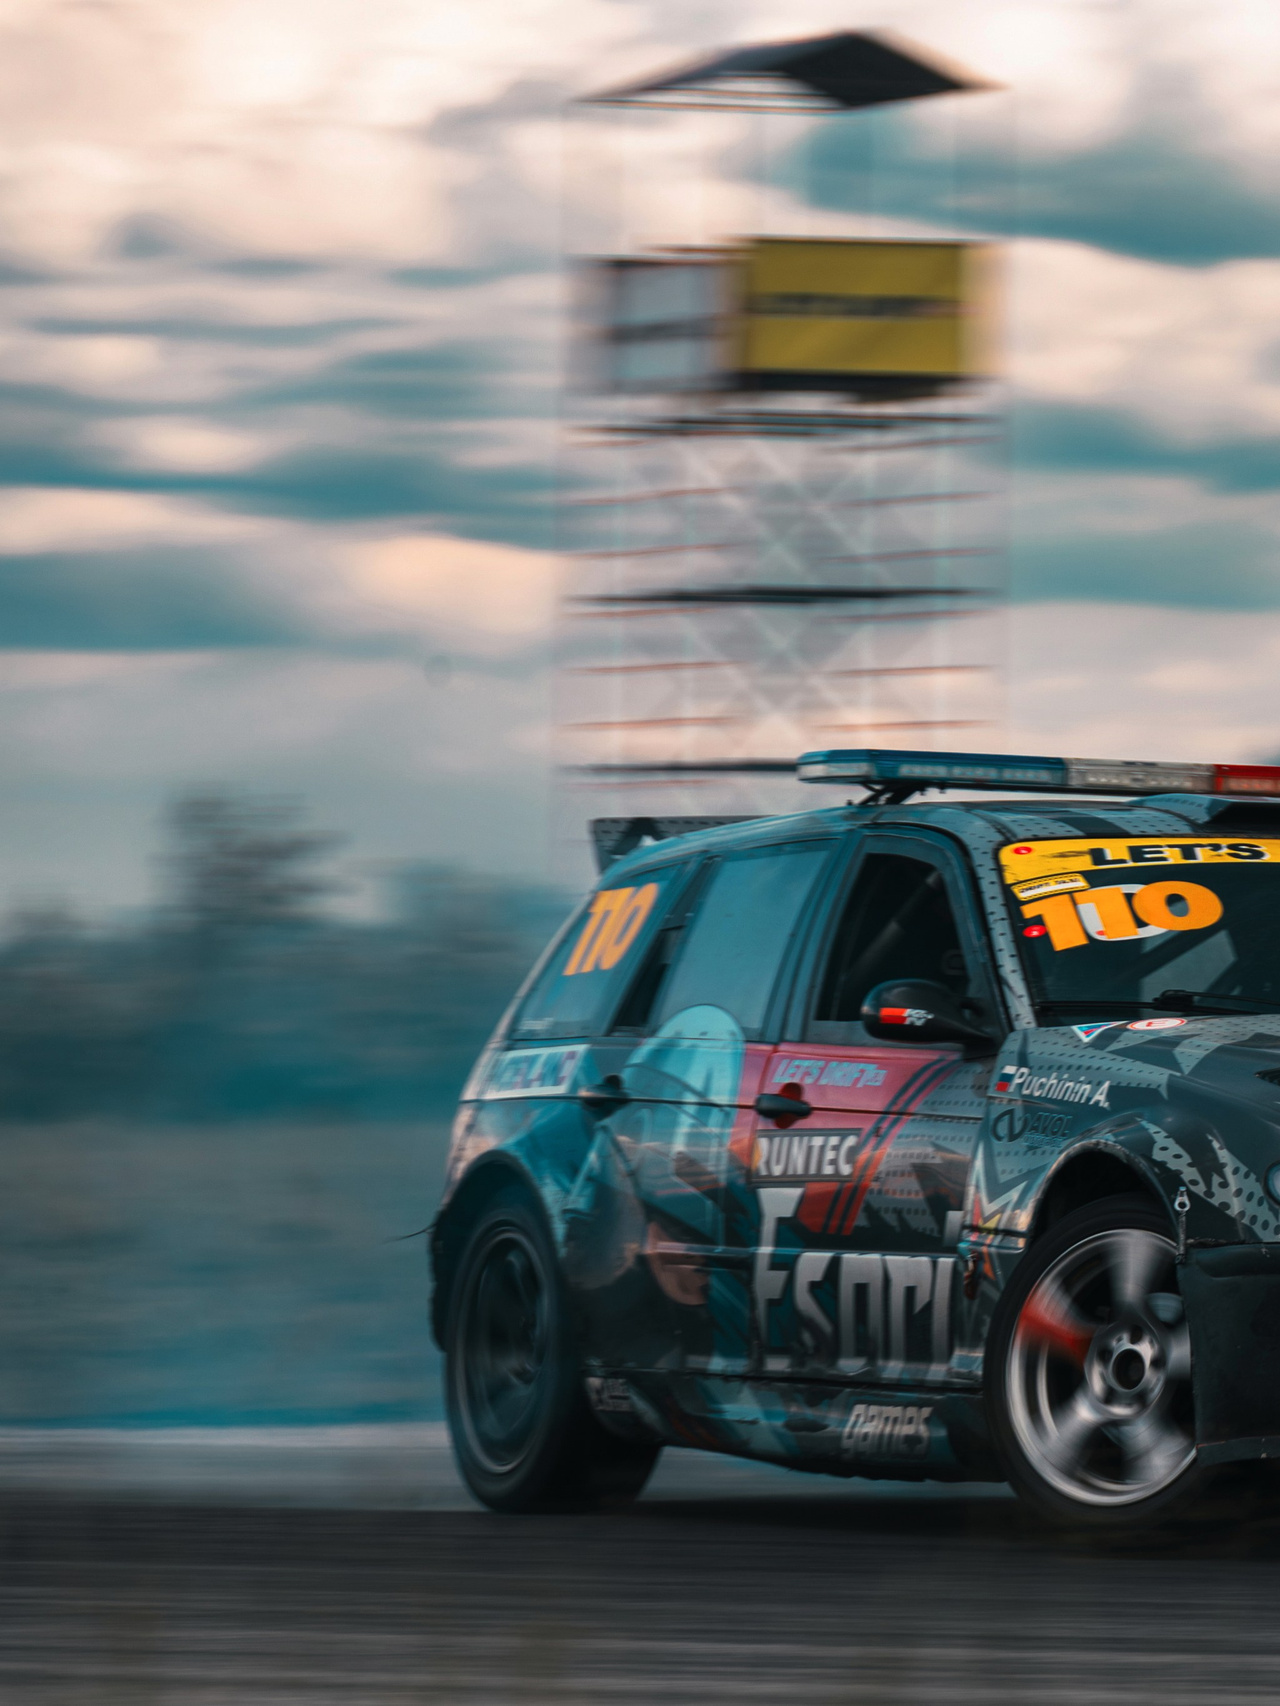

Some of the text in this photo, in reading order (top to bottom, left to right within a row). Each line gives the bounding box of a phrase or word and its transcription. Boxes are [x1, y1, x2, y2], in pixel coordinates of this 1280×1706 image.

[1088, 842, 1271, 868] LET'S
[562, 882, 659, 976] 110
[1020, 881, 1224, 951] 110
[1008, 1066, 1112, 1109] Puchinin A.
[756, 1135, 860, 1177] RUNTEC
[755, 1187, 964, 1378] Espri
